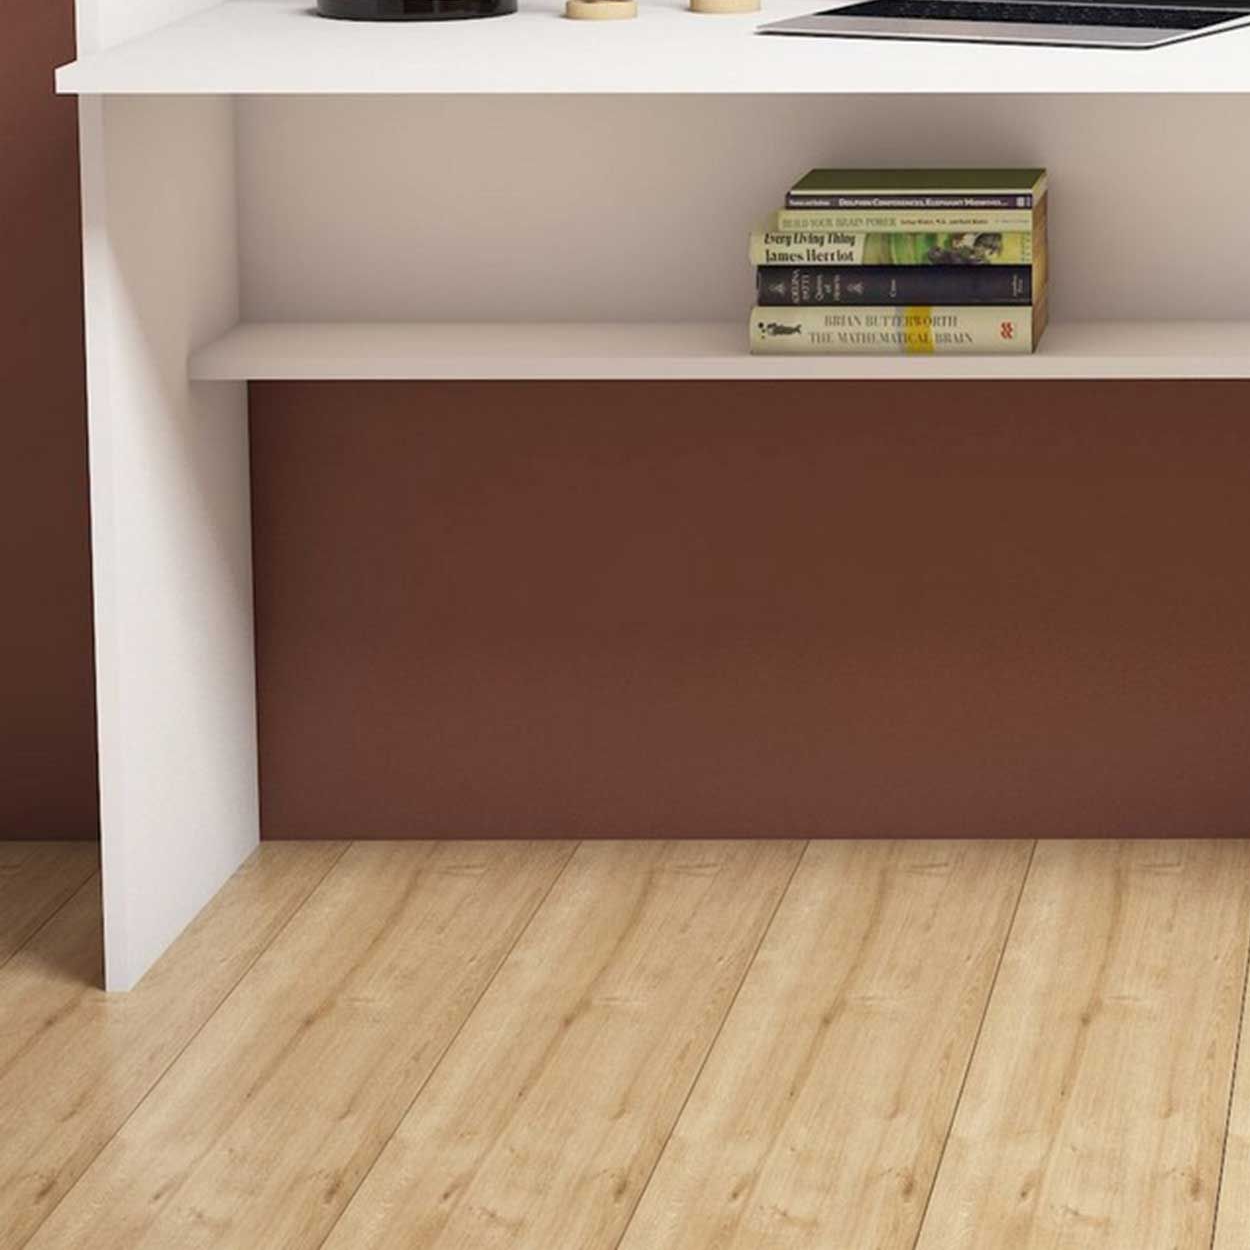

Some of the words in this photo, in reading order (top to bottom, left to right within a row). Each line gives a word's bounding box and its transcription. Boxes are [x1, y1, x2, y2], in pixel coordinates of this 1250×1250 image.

[764, 233, 791, 247] Every
[794, 233, 825, 247] Living
[828, 233, 856, 247] Thing
[766, 249, 804, 262] James
[806, 249, 854, 262] Herriot
[824, 315, 862, 327] BRIAN
[865, 315, 957, 327] BUTTERWORTH
[808, 332, 834, 344] THE
[837, 332, 932, 344] MATHEMATICAL
[934, 332, 973, 344] BRAIN
